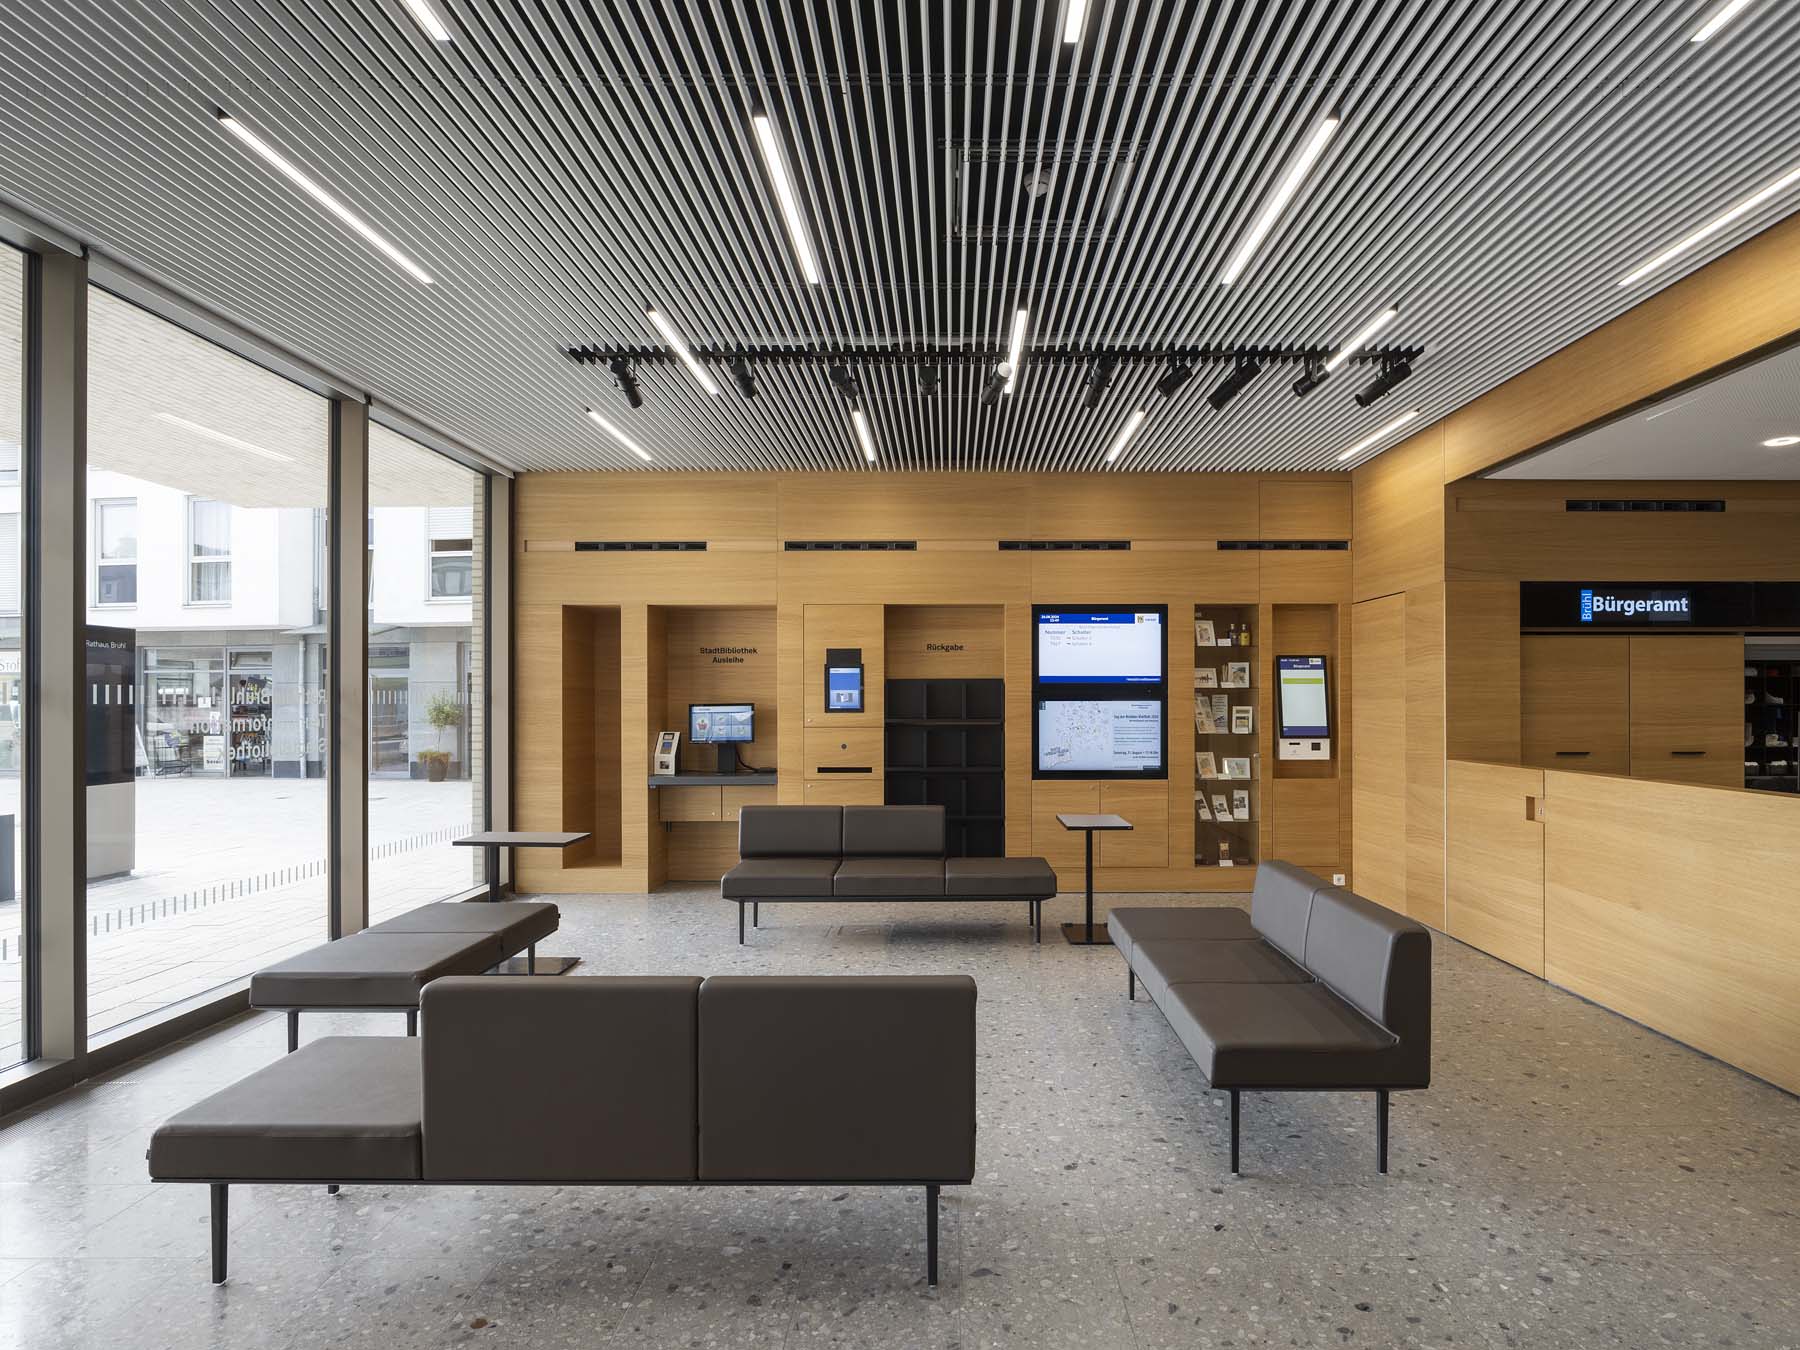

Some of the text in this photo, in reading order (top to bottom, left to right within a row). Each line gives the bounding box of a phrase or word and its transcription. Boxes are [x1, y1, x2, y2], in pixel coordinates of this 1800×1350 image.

[1582, 593, 1592, 620] Brühl
[1593, 596, 1689, 616] Bürgeramt
[86, 640, 110, 649] Rathaus
[927, 643, 964, 652] Rückgabe
